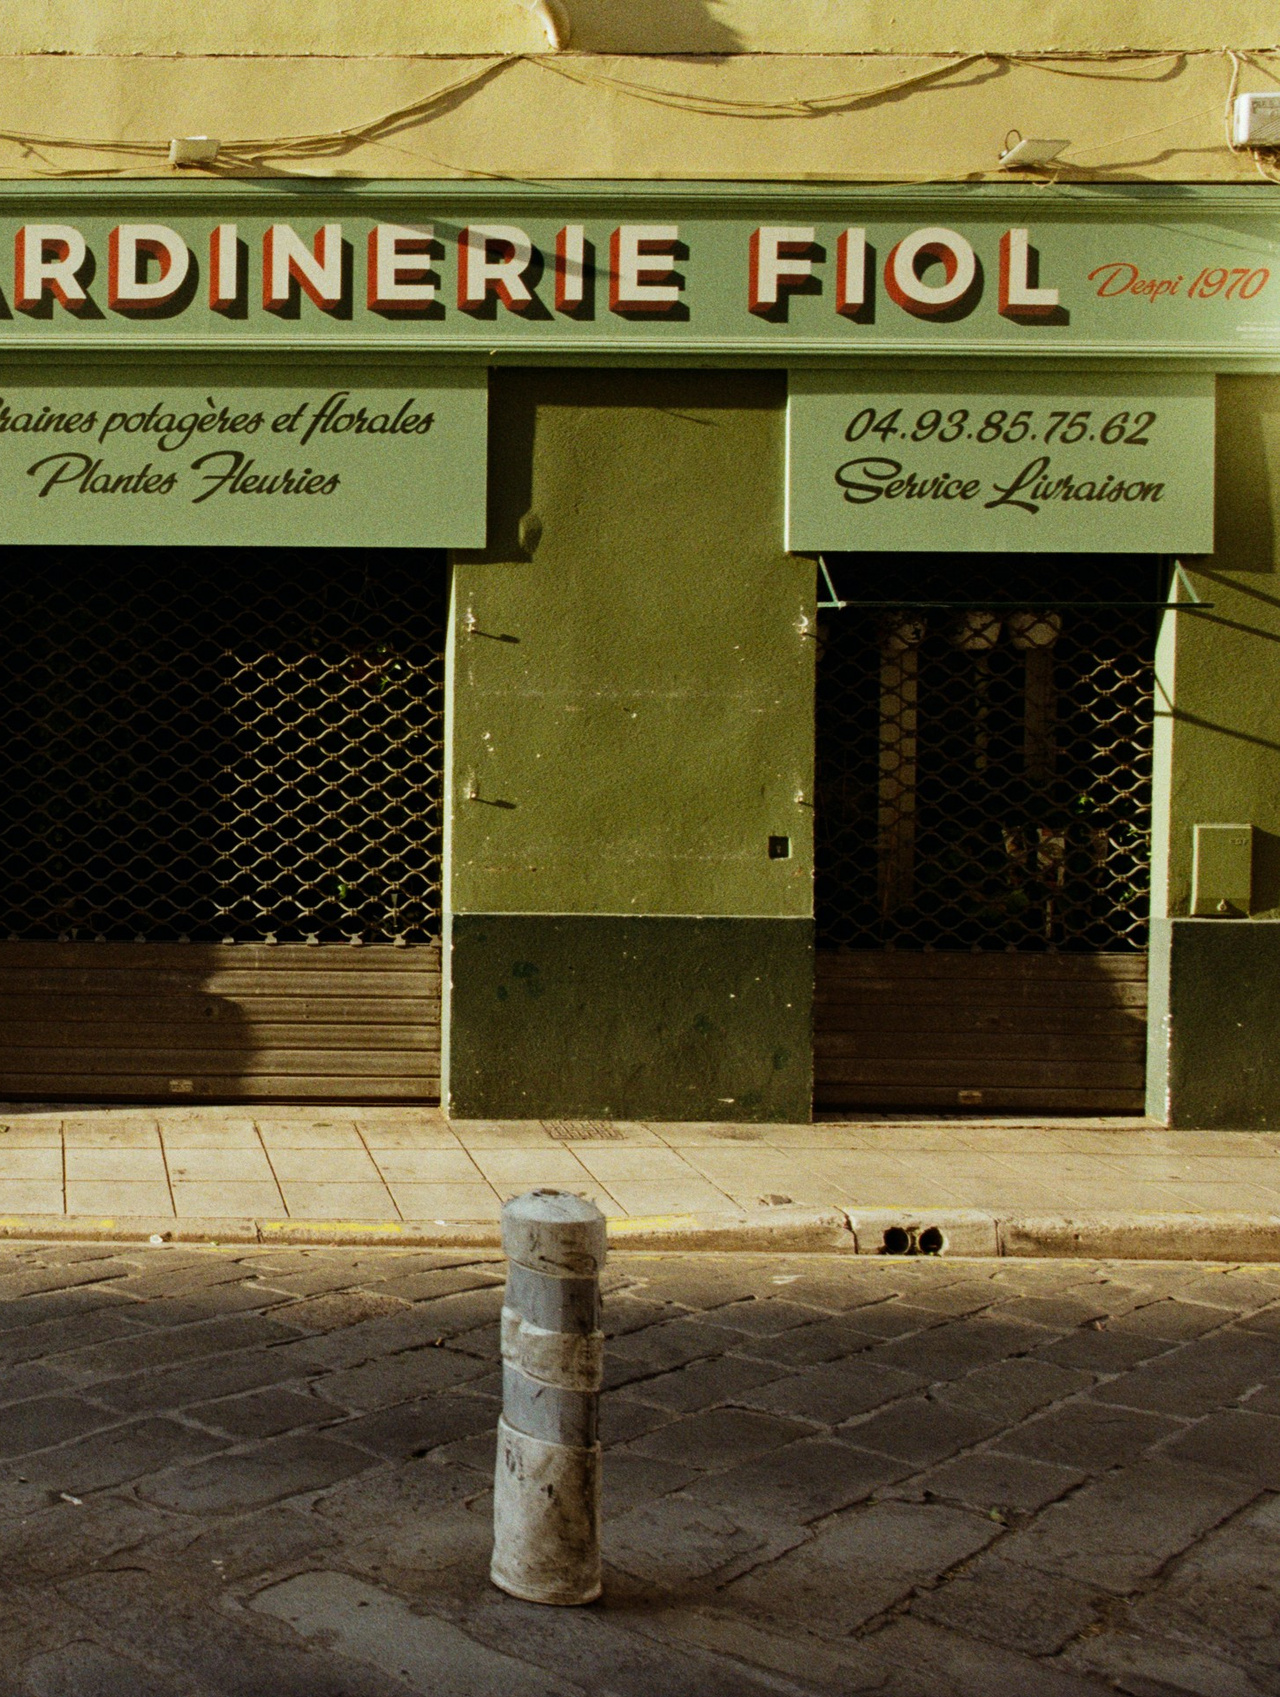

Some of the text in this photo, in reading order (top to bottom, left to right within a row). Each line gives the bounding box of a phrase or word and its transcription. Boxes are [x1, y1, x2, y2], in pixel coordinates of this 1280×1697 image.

[749, 225, 1070, 326] FIOL
[1187, 267, 1271, 300] 1970
[98, 396, 265, 453] potagères
[271, 401, 310, 435] et
[300, 390, 435, 447] florales
[844, 407, 1158, 447] 04.93.85.75.62
[26, 449, 341, 504] Plantes Fleuries
[834, 455, 1166, 515] Service Livraison
